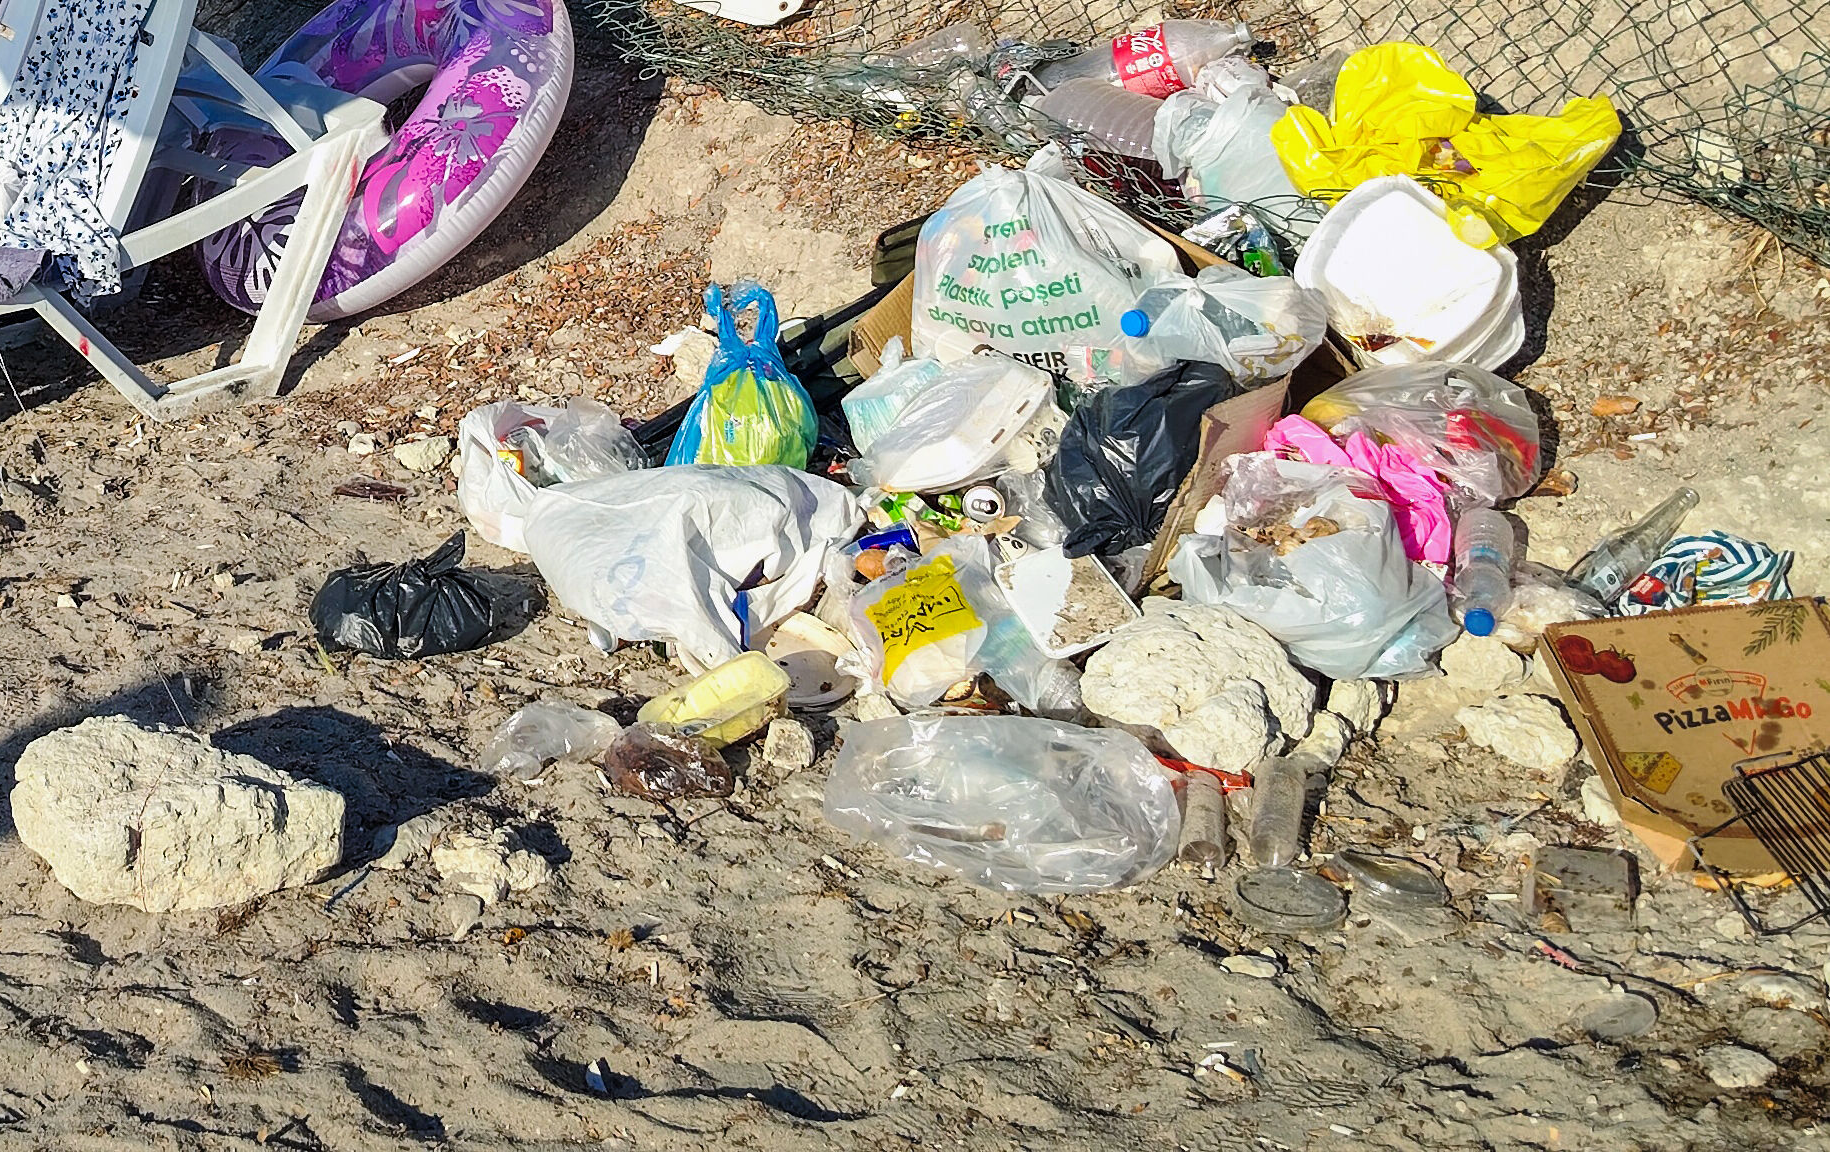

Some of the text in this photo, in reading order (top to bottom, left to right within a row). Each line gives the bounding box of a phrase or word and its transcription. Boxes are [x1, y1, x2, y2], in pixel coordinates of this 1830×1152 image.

[935, 272, 1083, 310] Plastik poşeti
[1021, 304, 1102, 337] atma!
